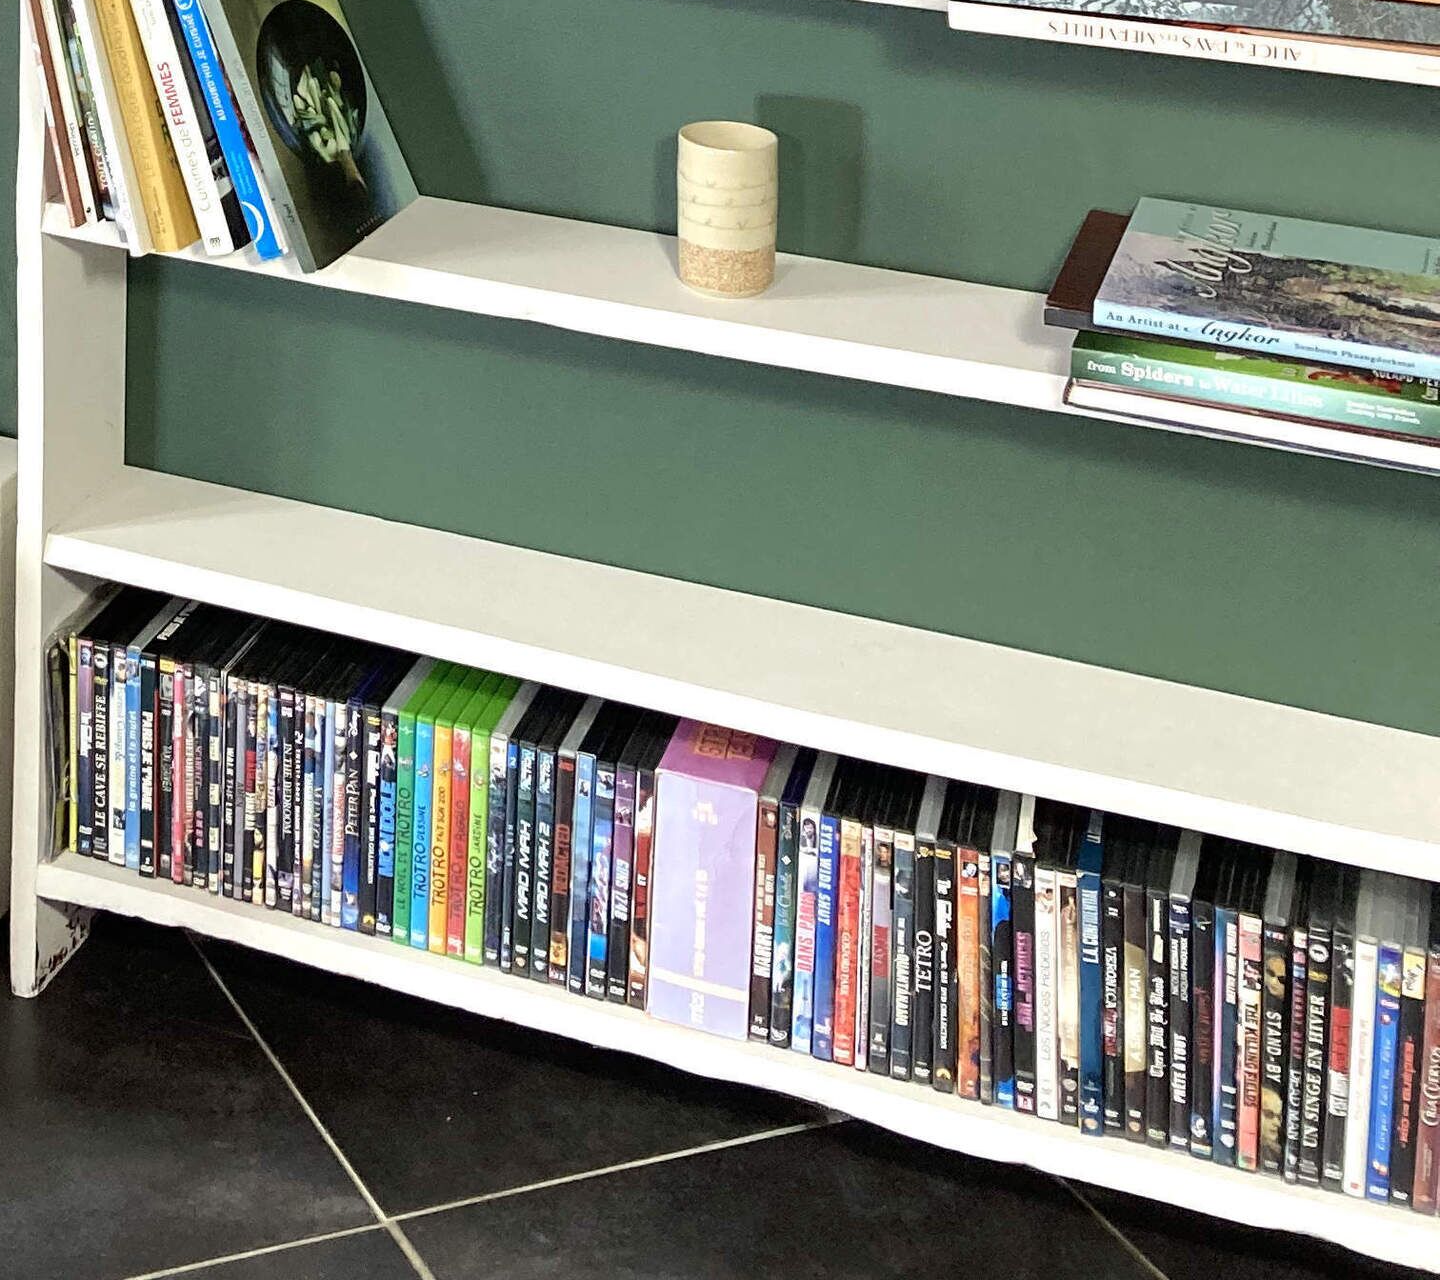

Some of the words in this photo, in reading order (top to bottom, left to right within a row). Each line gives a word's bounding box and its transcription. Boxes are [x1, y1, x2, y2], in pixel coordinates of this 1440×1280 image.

[184, 12, 206, 48] CUISINE
[1046, 20, 1159, 47] MERVEILLES
[1181, 33, 1228, 54] PAYS
[196, 49, 209, 59] JE
[1245, 42, 1301, 61] ALICE
[156, 60, 187, 126] FEMMES
[200, 61, 228, 121] AUJOURD'HUI
[178, 125, 195, 146] de
[185, 149, 212, 211] Cuisines
[1105, 310, 1125, 323] An
[1127, 313, 1165, 329] Artist
[1167, 320, 1181, 332] at
[1086, 358, 1117, 376] from
[1120, 361, 1194, 389] Spiders
[95, 693, 107, 749] REBIFFE
[128, 709, 137, 739] mulet
[129, 740, 137, 749] le
[129, 751, 137, 762] et
[283, 743, 292, 757] IN
[95, 752, 106, 770] SE
[283, 759, 292, 778] THE
[95, 772, 106, 807] CAVE
[129, 764, 137, 798] graine
[346, 767, 360, 794] PAN
[95, 809, 106, 827] LE
[129, 799, 137, 811] la
[345, 796, 359, 836] PETER
[378, 779, 397, 833] IDOLE
[539, 820, 551, 836] 2
[820, 823, 833, 854] EYES
[413, 841, 427, 898] TROTRO
[553, 822, 570, 895] REDACTED
[818, 858, 832, 890] WIDE
[468, 855, 484, 916] TROTRO
[536, 881, 549, 923] MAD
[797, 891, 816, 936] PARIS
[816, 893, 831, 926] SHUT
[795, 936, 814, 973] DANS
[914, 931, 933, 994] TETRO
[1244, 1003, 1259, 1024] THE
[1307, 993, 1325, 1045] HIVER
[1243, 1026, 1258, 1069] KILLING
[1306, 1046, 1323, 1068] EN
[1242, 1070, 1258, 1108] FIELDS
[1304, 1071, 1322, 1121] SINGE
[1303, 1124, 1318, 1147] UN
